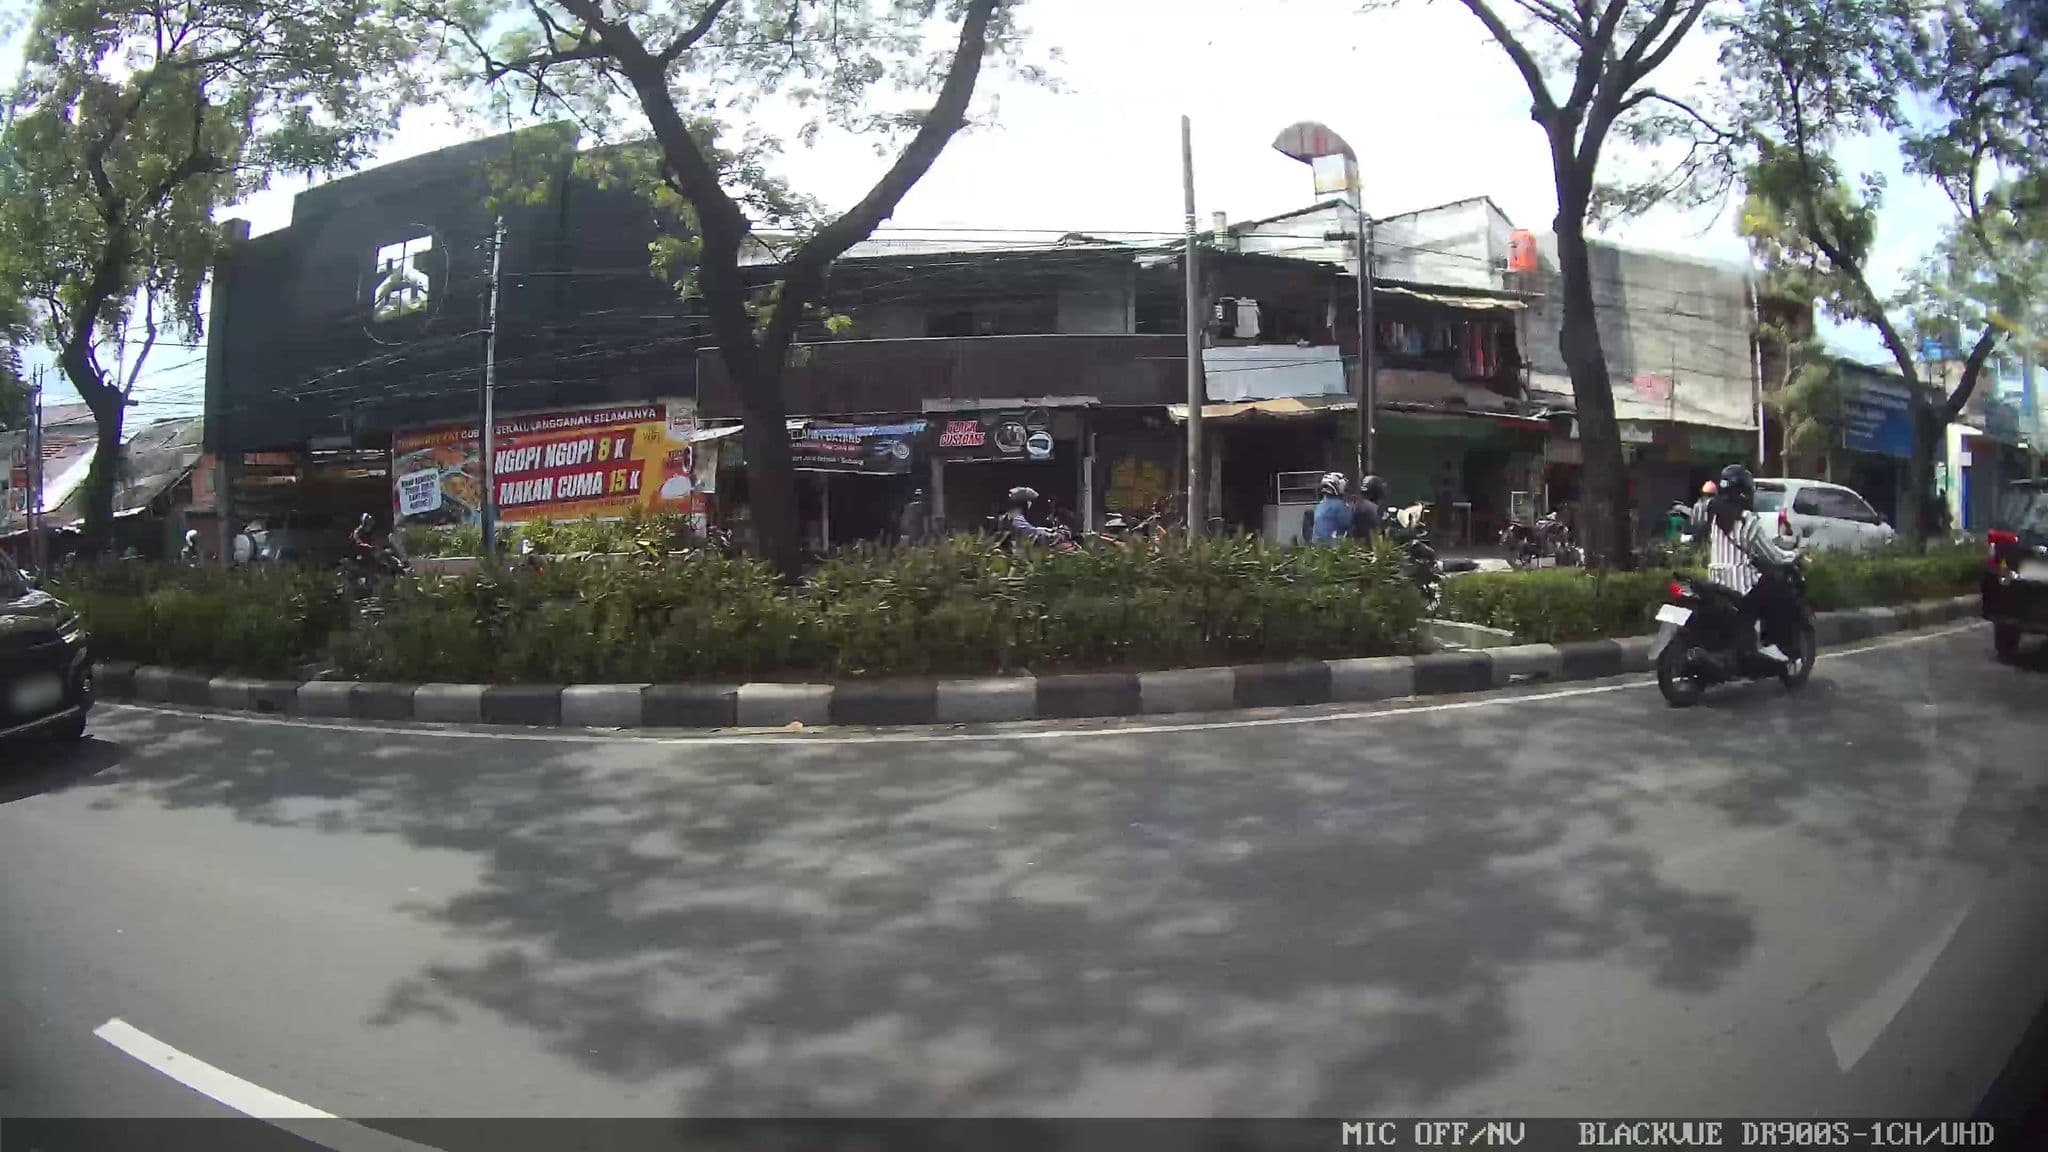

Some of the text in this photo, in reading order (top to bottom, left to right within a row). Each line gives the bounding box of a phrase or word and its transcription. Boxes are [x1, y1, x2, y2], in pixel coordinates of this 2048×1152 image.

[531, 413, 592, 431] LANGGANAN
[593, 408, 656, 424] SELAMANYA
[494, 436, 626, 475] NGOPI NGOPI 8 K
[499, 468, 641, 505] MAKAN CUMA 15 K
